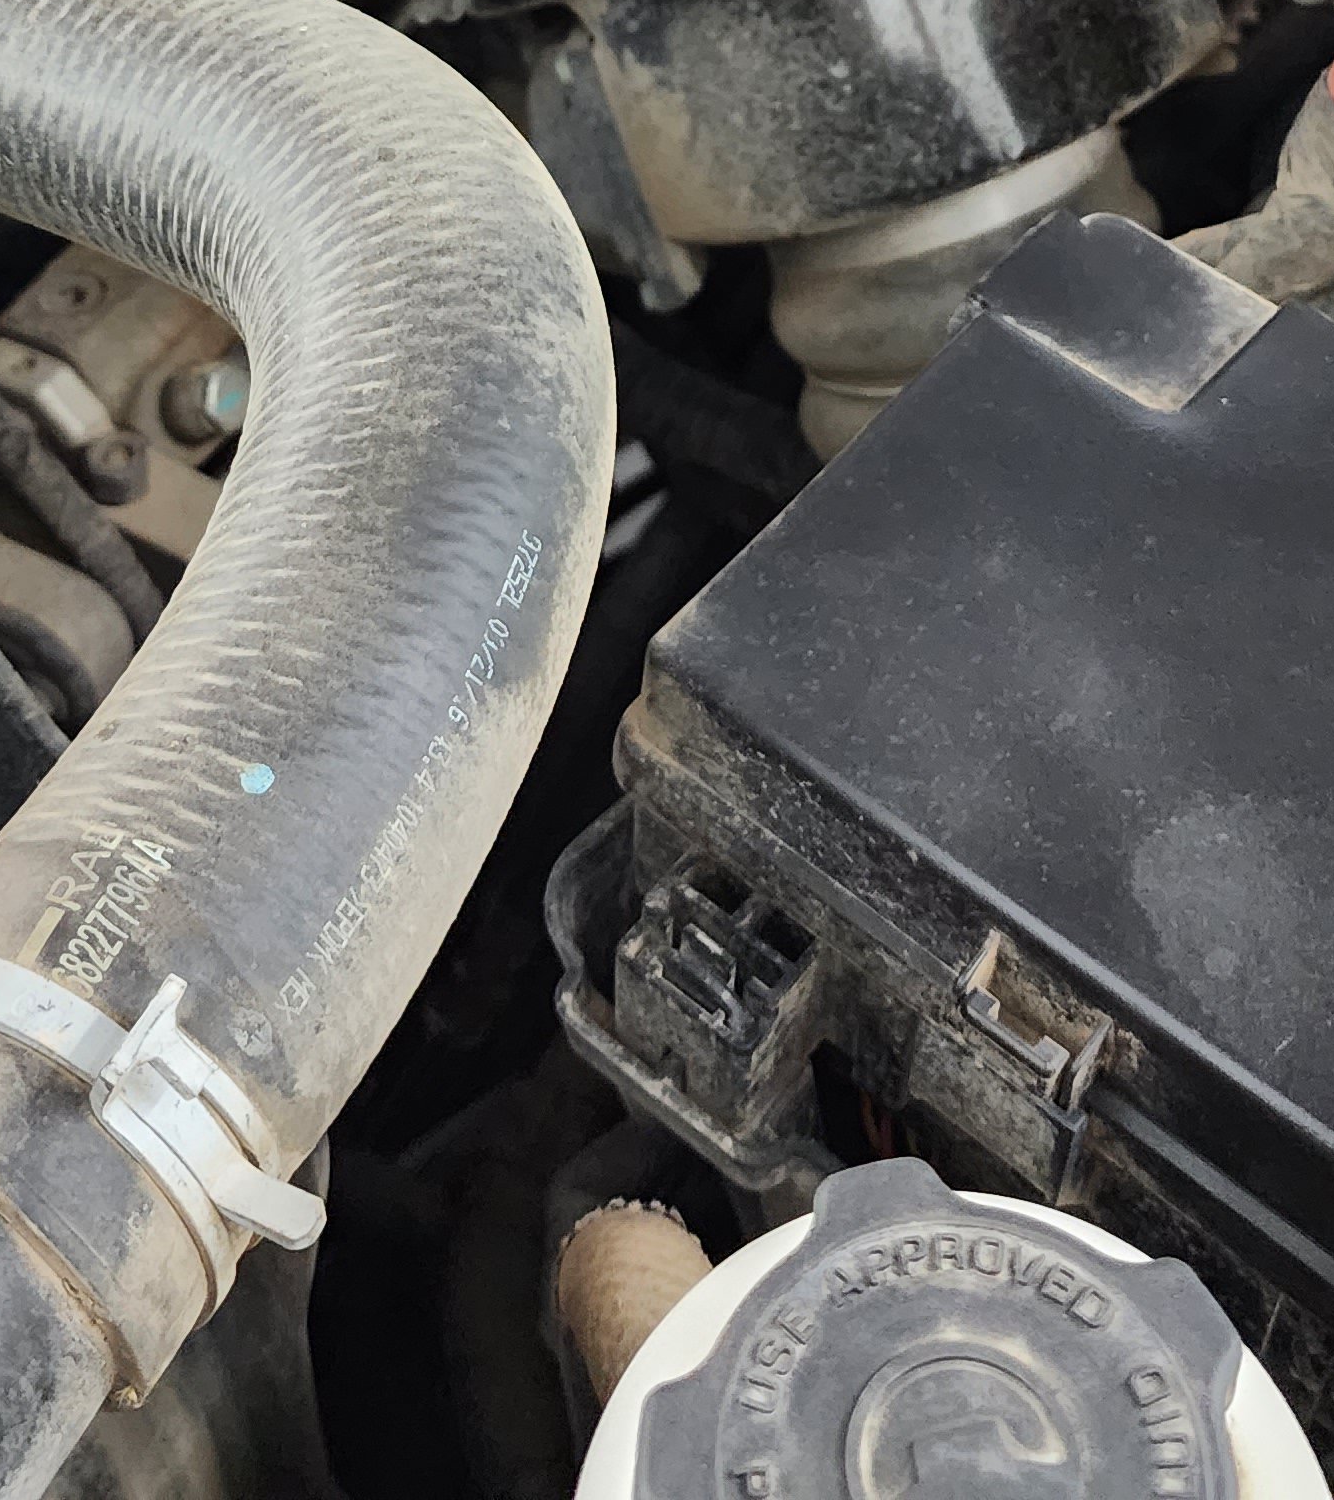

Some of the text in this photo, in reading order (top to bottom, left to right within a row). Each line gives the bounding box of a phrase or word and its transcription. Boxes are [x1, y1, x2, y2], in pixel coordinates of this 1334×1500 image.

[269, 966, 318, 1023] MEX
[738, 1232, 1115, 1415] USE APPROVED
